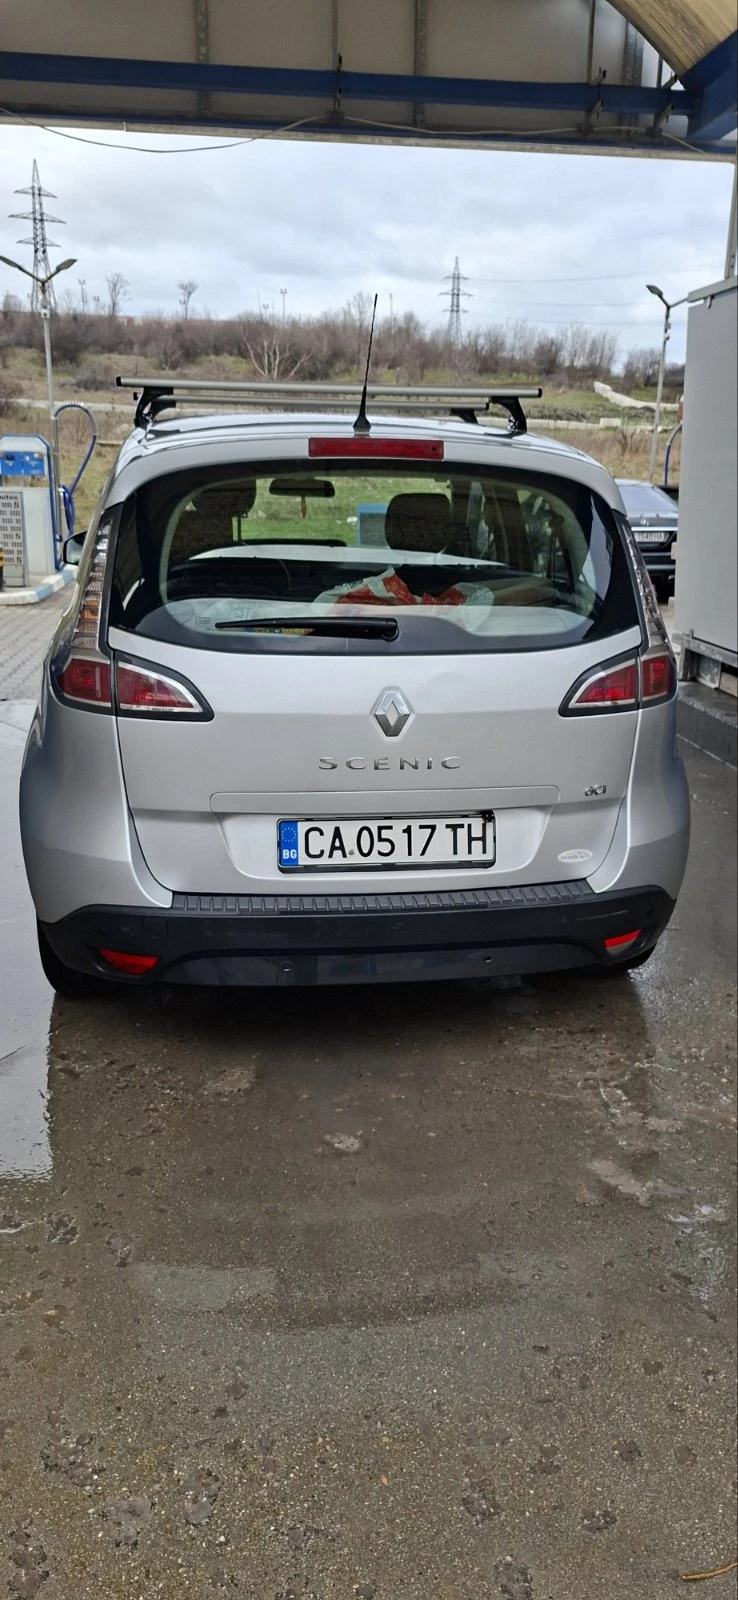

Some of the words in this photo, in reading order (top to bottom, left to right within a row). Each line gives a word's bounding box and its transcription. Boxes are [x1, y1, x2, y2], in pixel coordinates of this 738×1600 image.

[318, 756, 461, 771] SCENIC
[304, 826, 348, 859] CA
[356, 825, 437, 858] 0517
[445, 823, 488, 855] TH
[282, 850, 298, 860] BG
